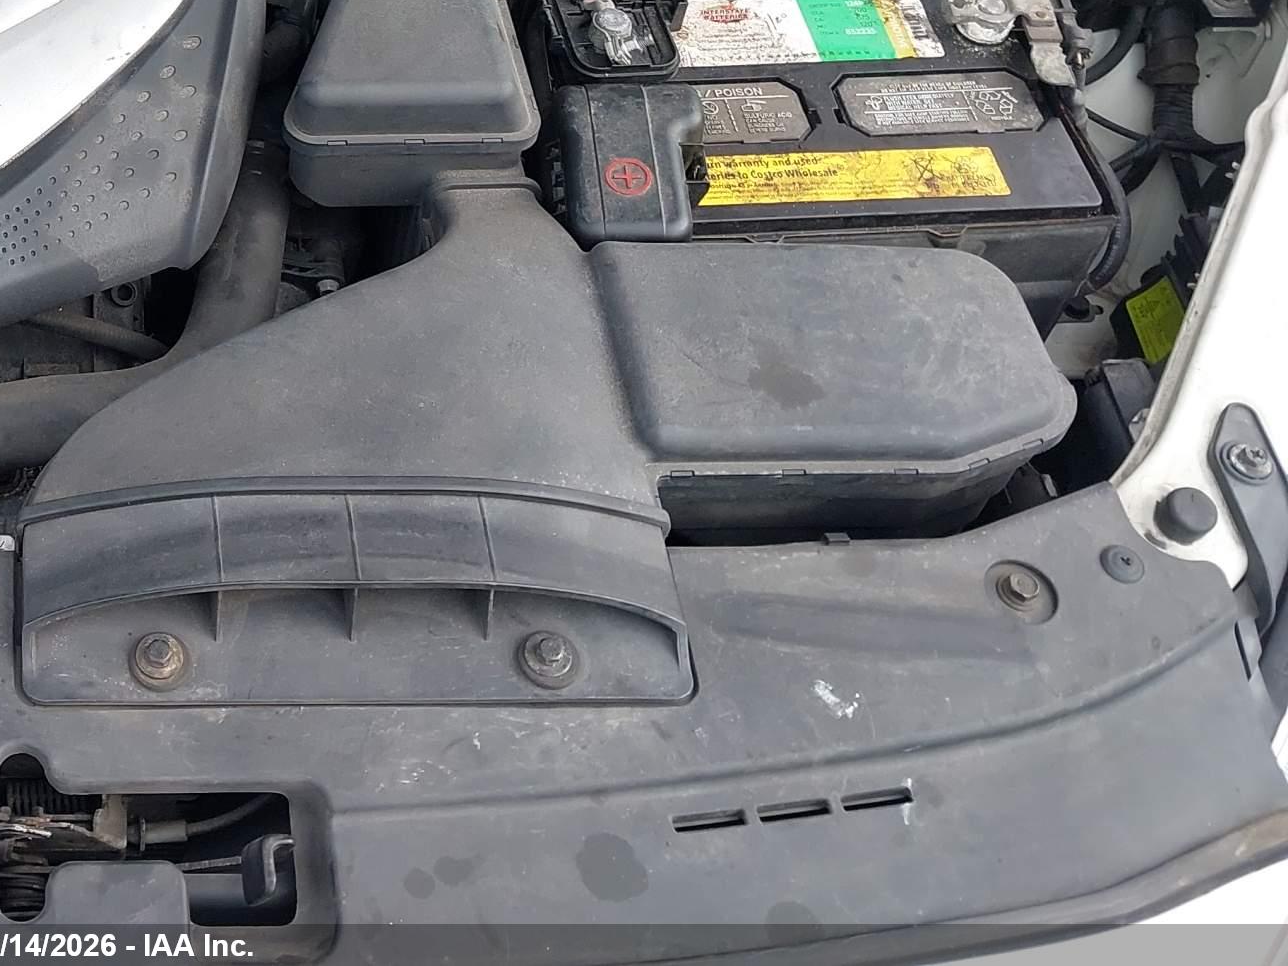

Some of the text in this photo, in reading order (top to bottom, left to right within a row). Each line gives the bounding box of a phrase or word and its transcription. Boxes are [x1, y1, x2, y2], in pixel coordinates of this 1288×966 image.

[700, 7, 751, 16] INTERSTATE
[715, 87, 763, 97] POISON
[724, 158, 770, 169] warranty
[772, 157, 791, 166] and
[793, 156, 818, 166] used
[738, 171, 749, 180] to
[751, 170, 783, 179] Costco
[785, 168, 838, 178] Wholesale
